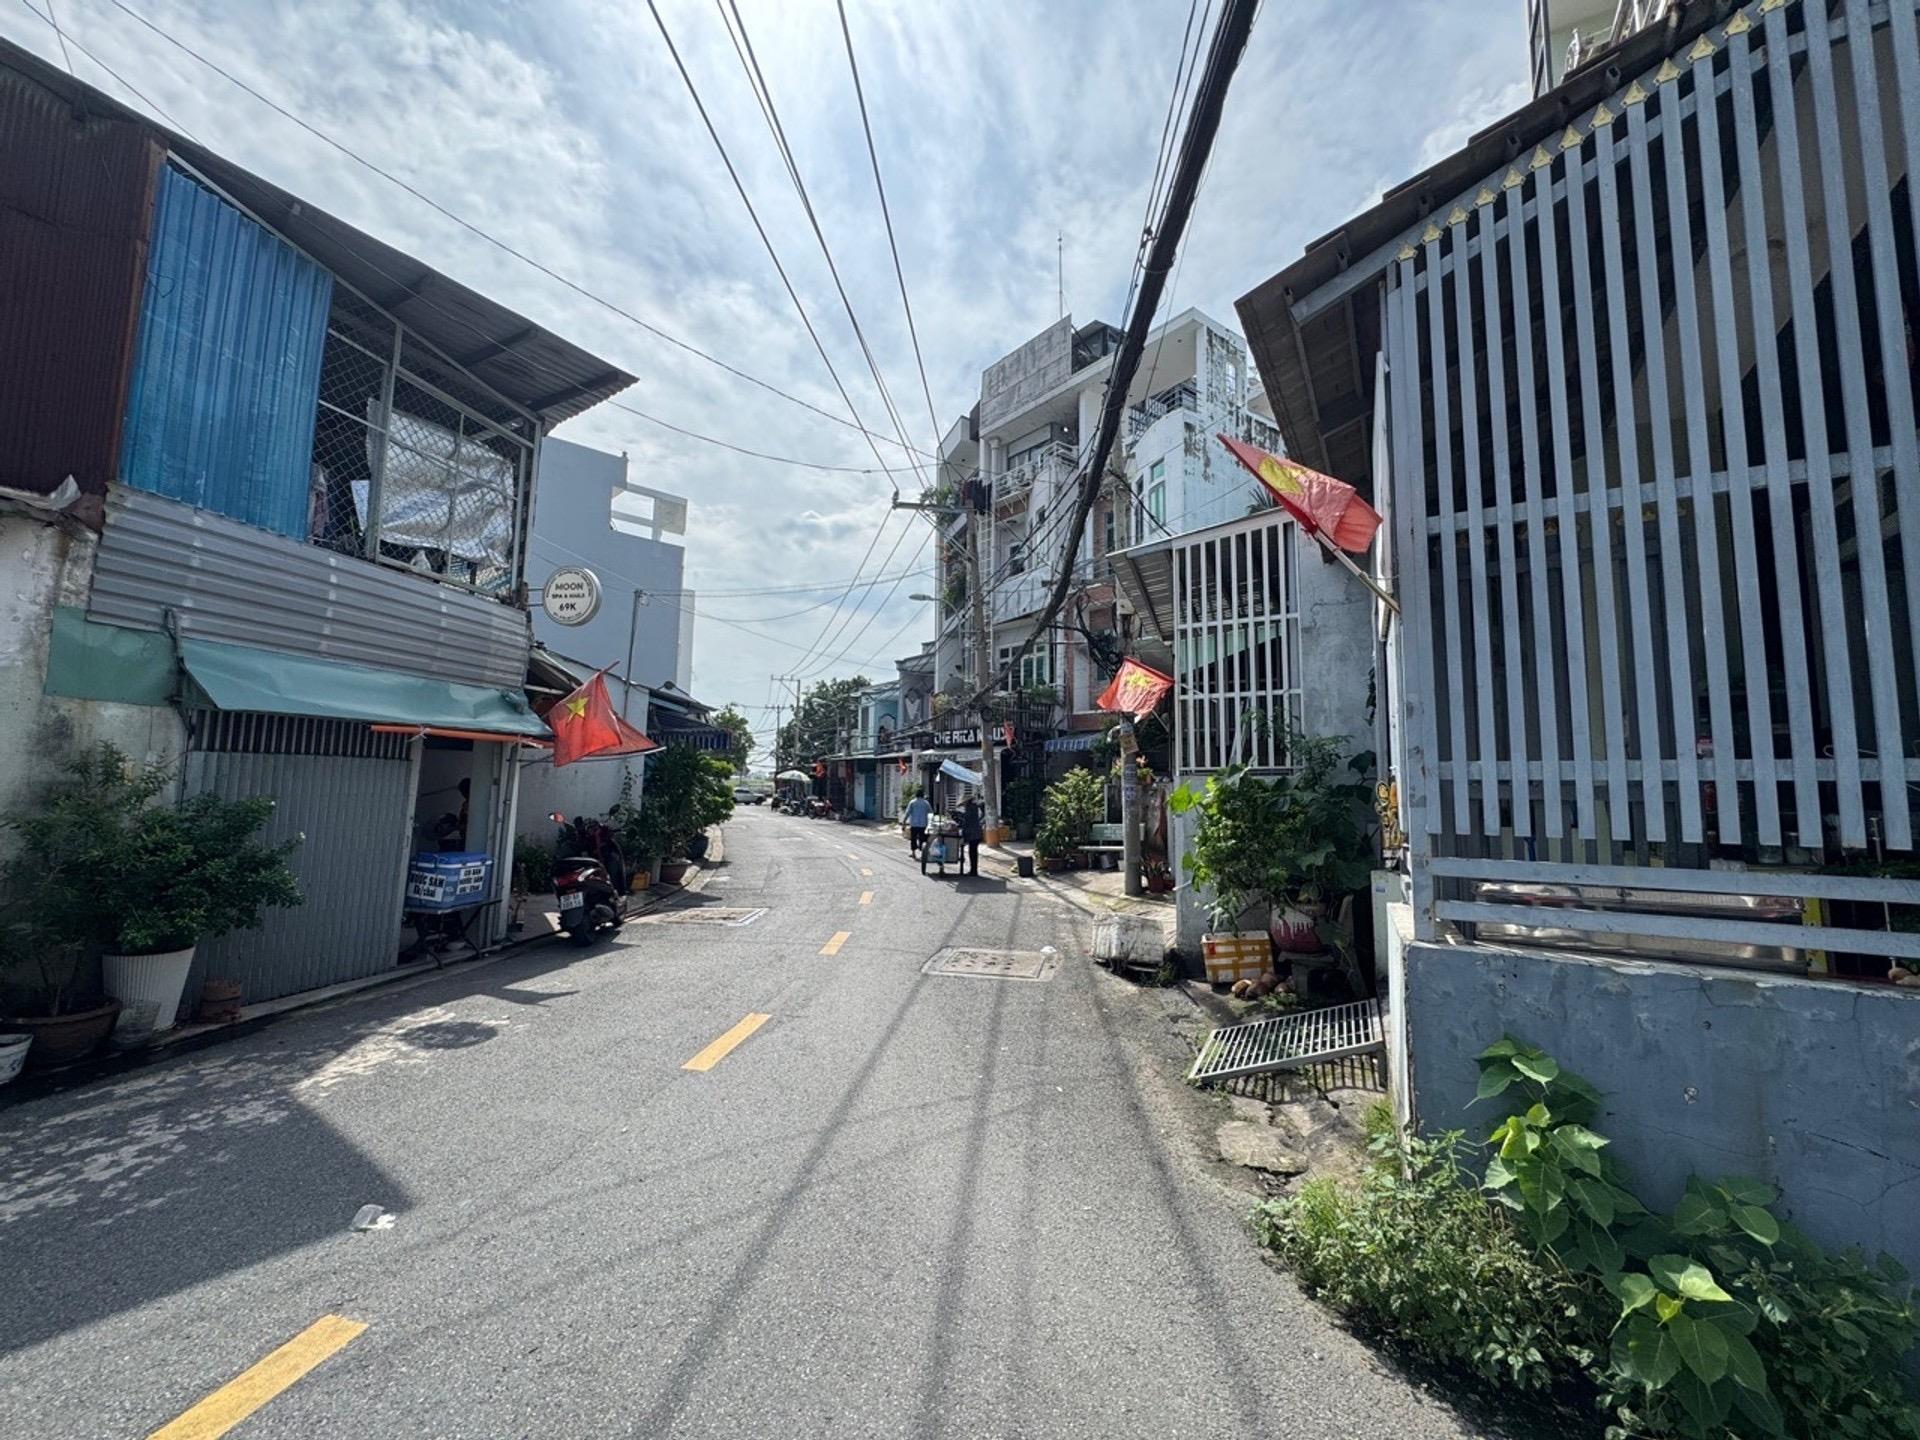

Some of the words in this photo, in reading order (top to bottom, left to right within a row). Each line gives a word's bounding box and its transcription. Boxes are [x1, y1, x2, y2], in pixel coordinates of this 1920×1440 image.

[555, 582, 583, 590] MOON
[559, 602, 577, 611] 69K
[952, 728, 975, 744] RITA
